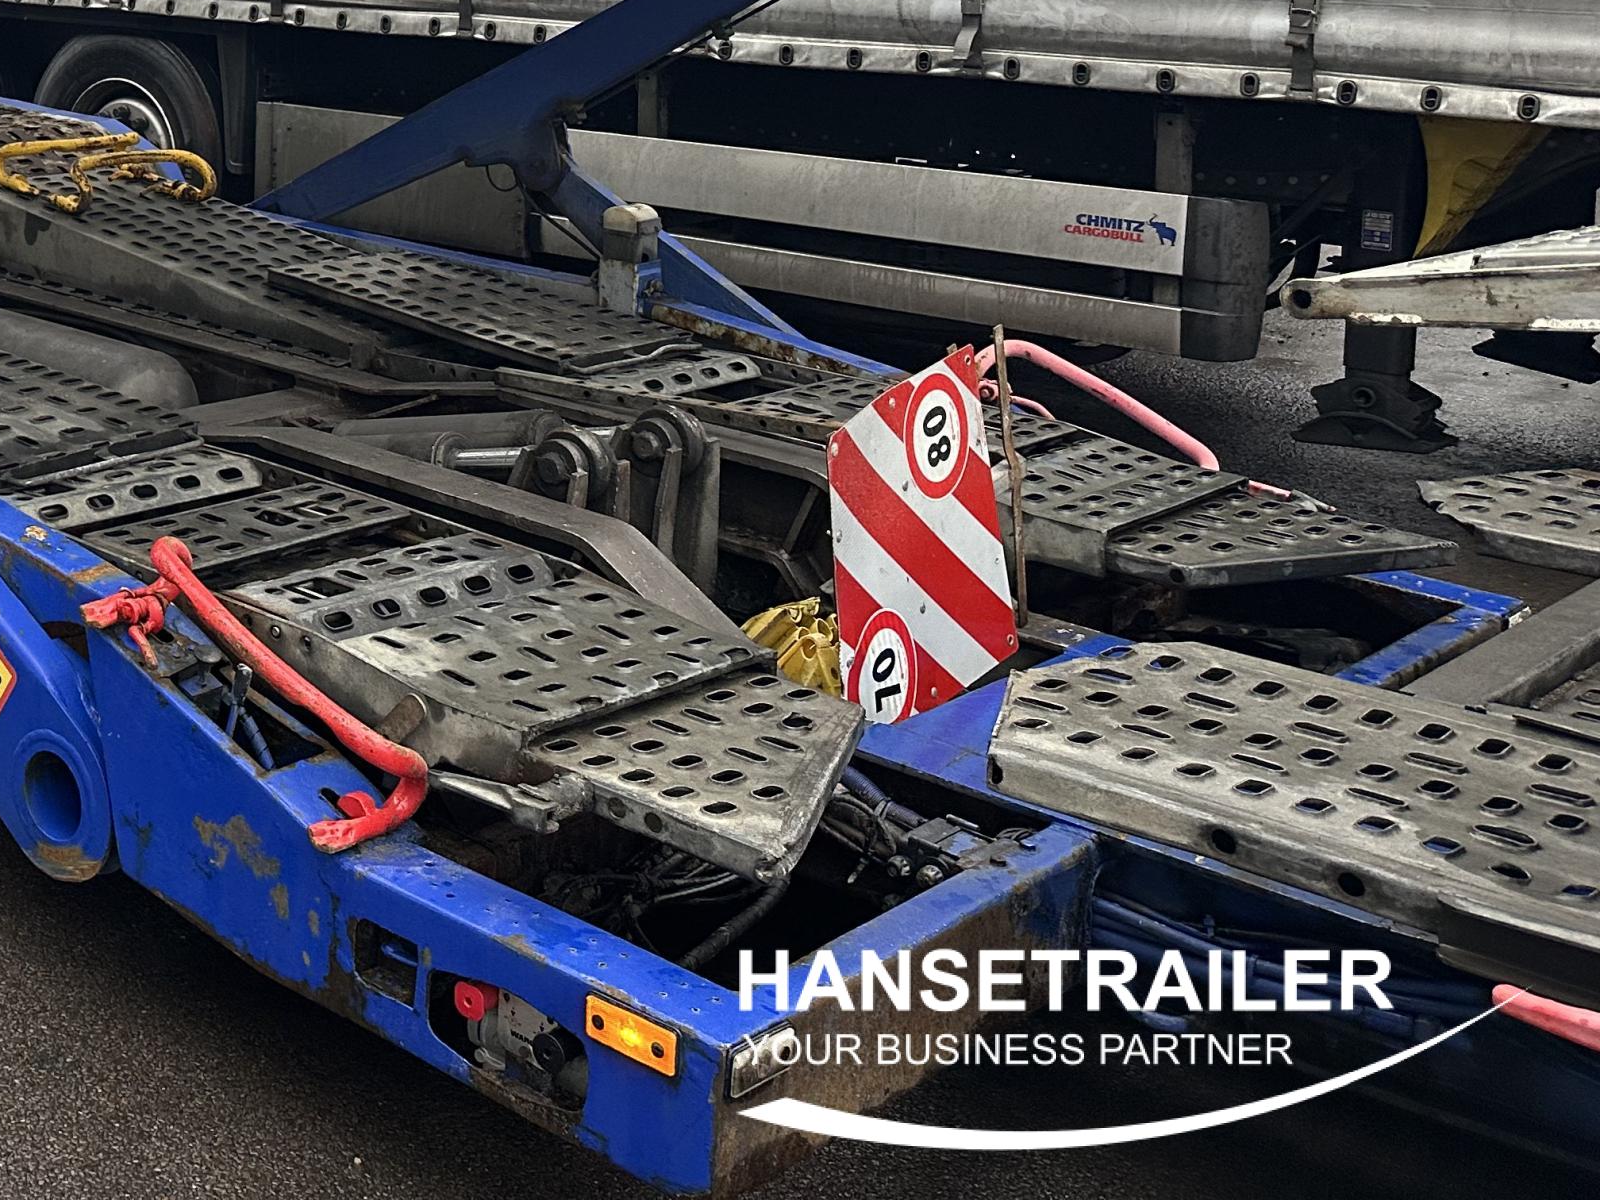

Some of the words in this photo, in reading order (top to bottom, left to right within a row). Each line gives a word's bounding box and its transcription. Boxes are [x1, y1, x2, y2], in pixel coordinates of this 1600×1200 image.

[1064, 224, 1144, 243] CARGOBULL
[923, 406, 951, 467] 80
[872, 648, 902, 714] 70
